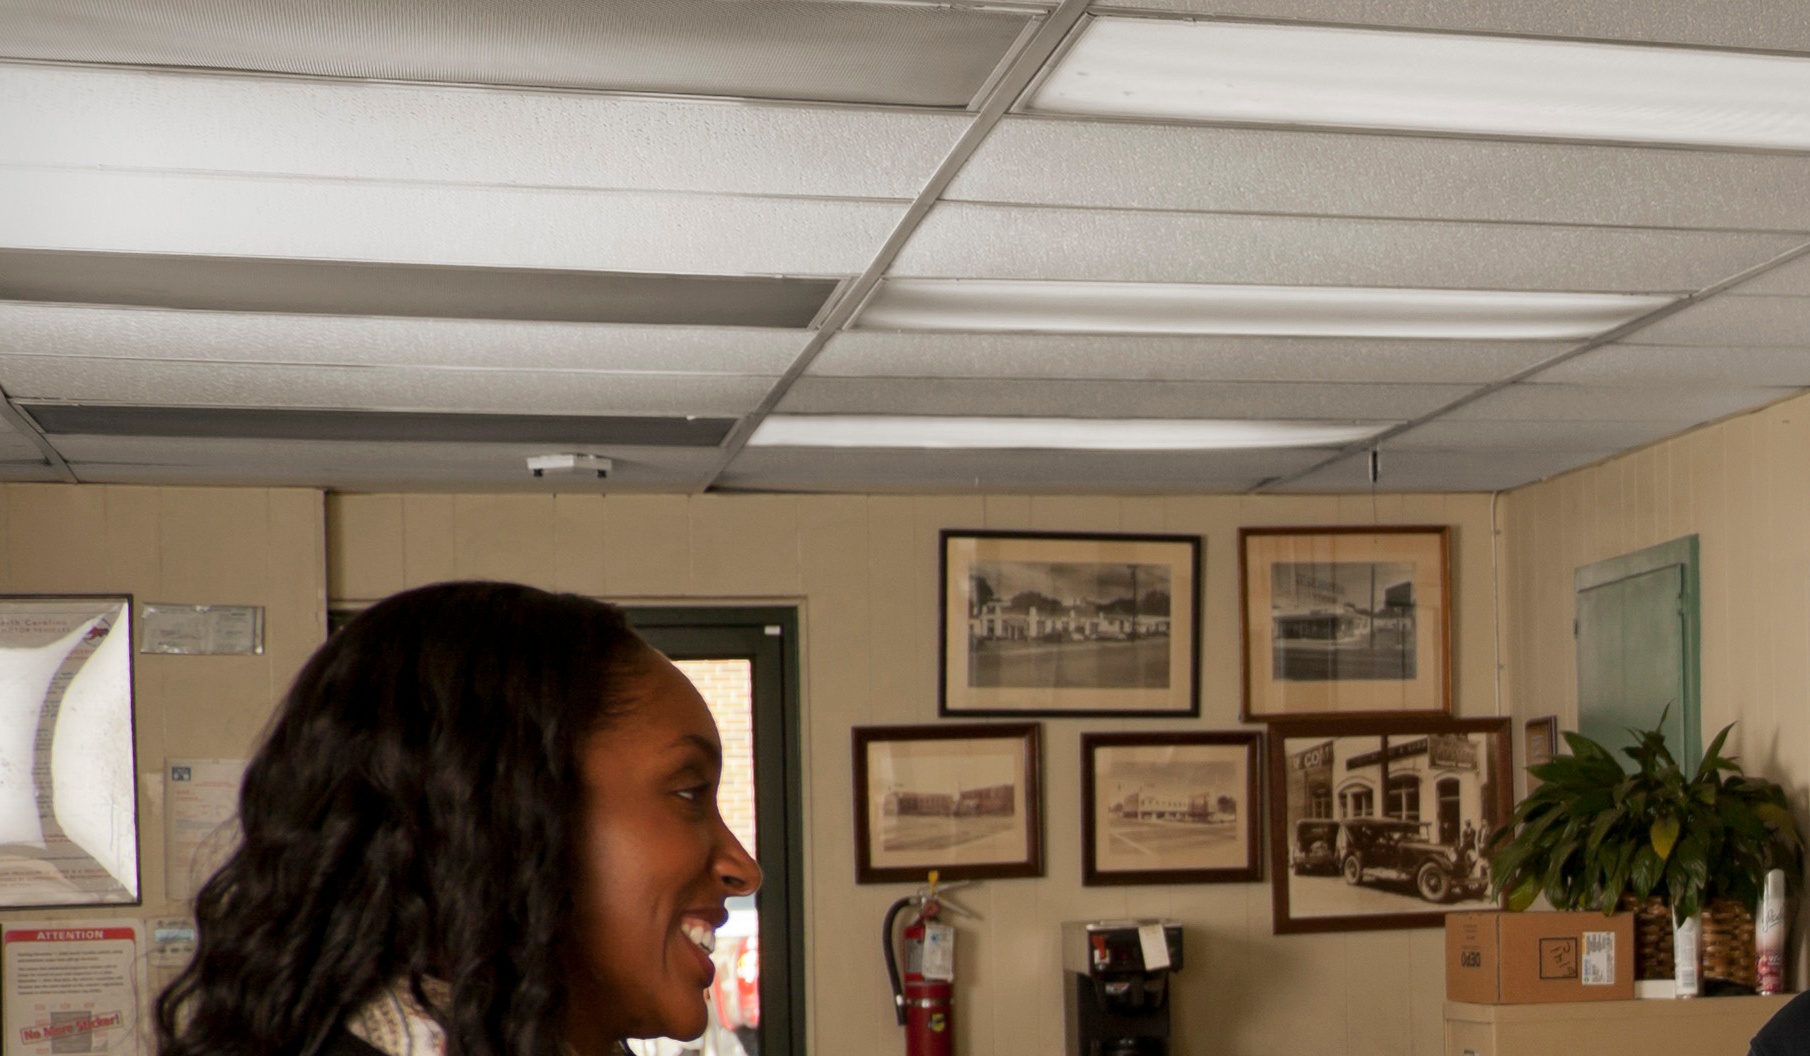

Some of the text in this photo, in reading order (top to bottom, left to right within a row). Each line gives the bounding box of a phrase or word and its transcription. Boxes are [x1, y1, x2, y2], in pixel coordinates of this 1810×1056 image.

[37, 931, 103, 940] ATTENTION
[24, 1030, 41, 1040] No
[43, 1025, 73, 1037] More
